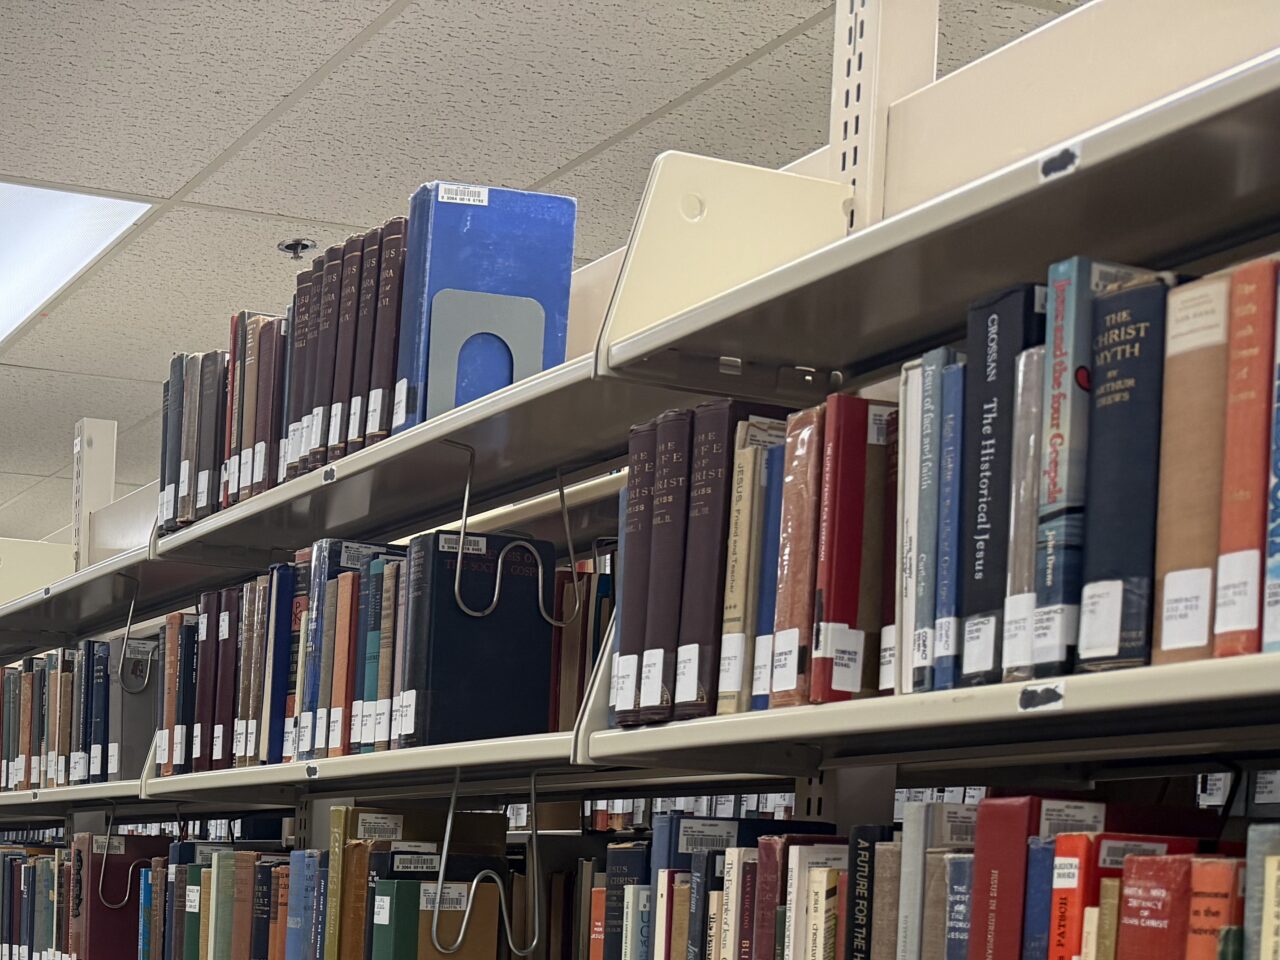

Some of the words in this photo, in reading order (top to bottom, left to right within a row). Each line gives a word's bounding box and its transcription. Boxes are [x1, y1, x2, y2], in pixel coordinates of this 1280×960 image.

[1104, 309, 1132, 327] THE
[986, 314, 999, 382] CROSSAN
[1096, 322, 1150, 348] HRIST
[923, 398, 934, 410] of
[981, 398, 998, 436] The
[923, 413, 934, 434] fact
[920, 462, 933, 489] faith
[976, 439, 996, 530] Historical
[973, 534, 990, 580] Jesus
[857, 839, 869, 848] A
[725, 860, 734, 877] The
[855, 850, 868, 896] FUTURE
[690, 871, 701, 913] Morrison
[989, 869, 999, 897] JESUS
[722, 879, 732, 916] Example
[854, 899, 866, 925] FOR
[721, 928, 730, 949] Jesus
[740, 940, 750, 958] BLI
[853, 927, 866, 950] THE
[985, 912, 996, 960] EUROPEAN
